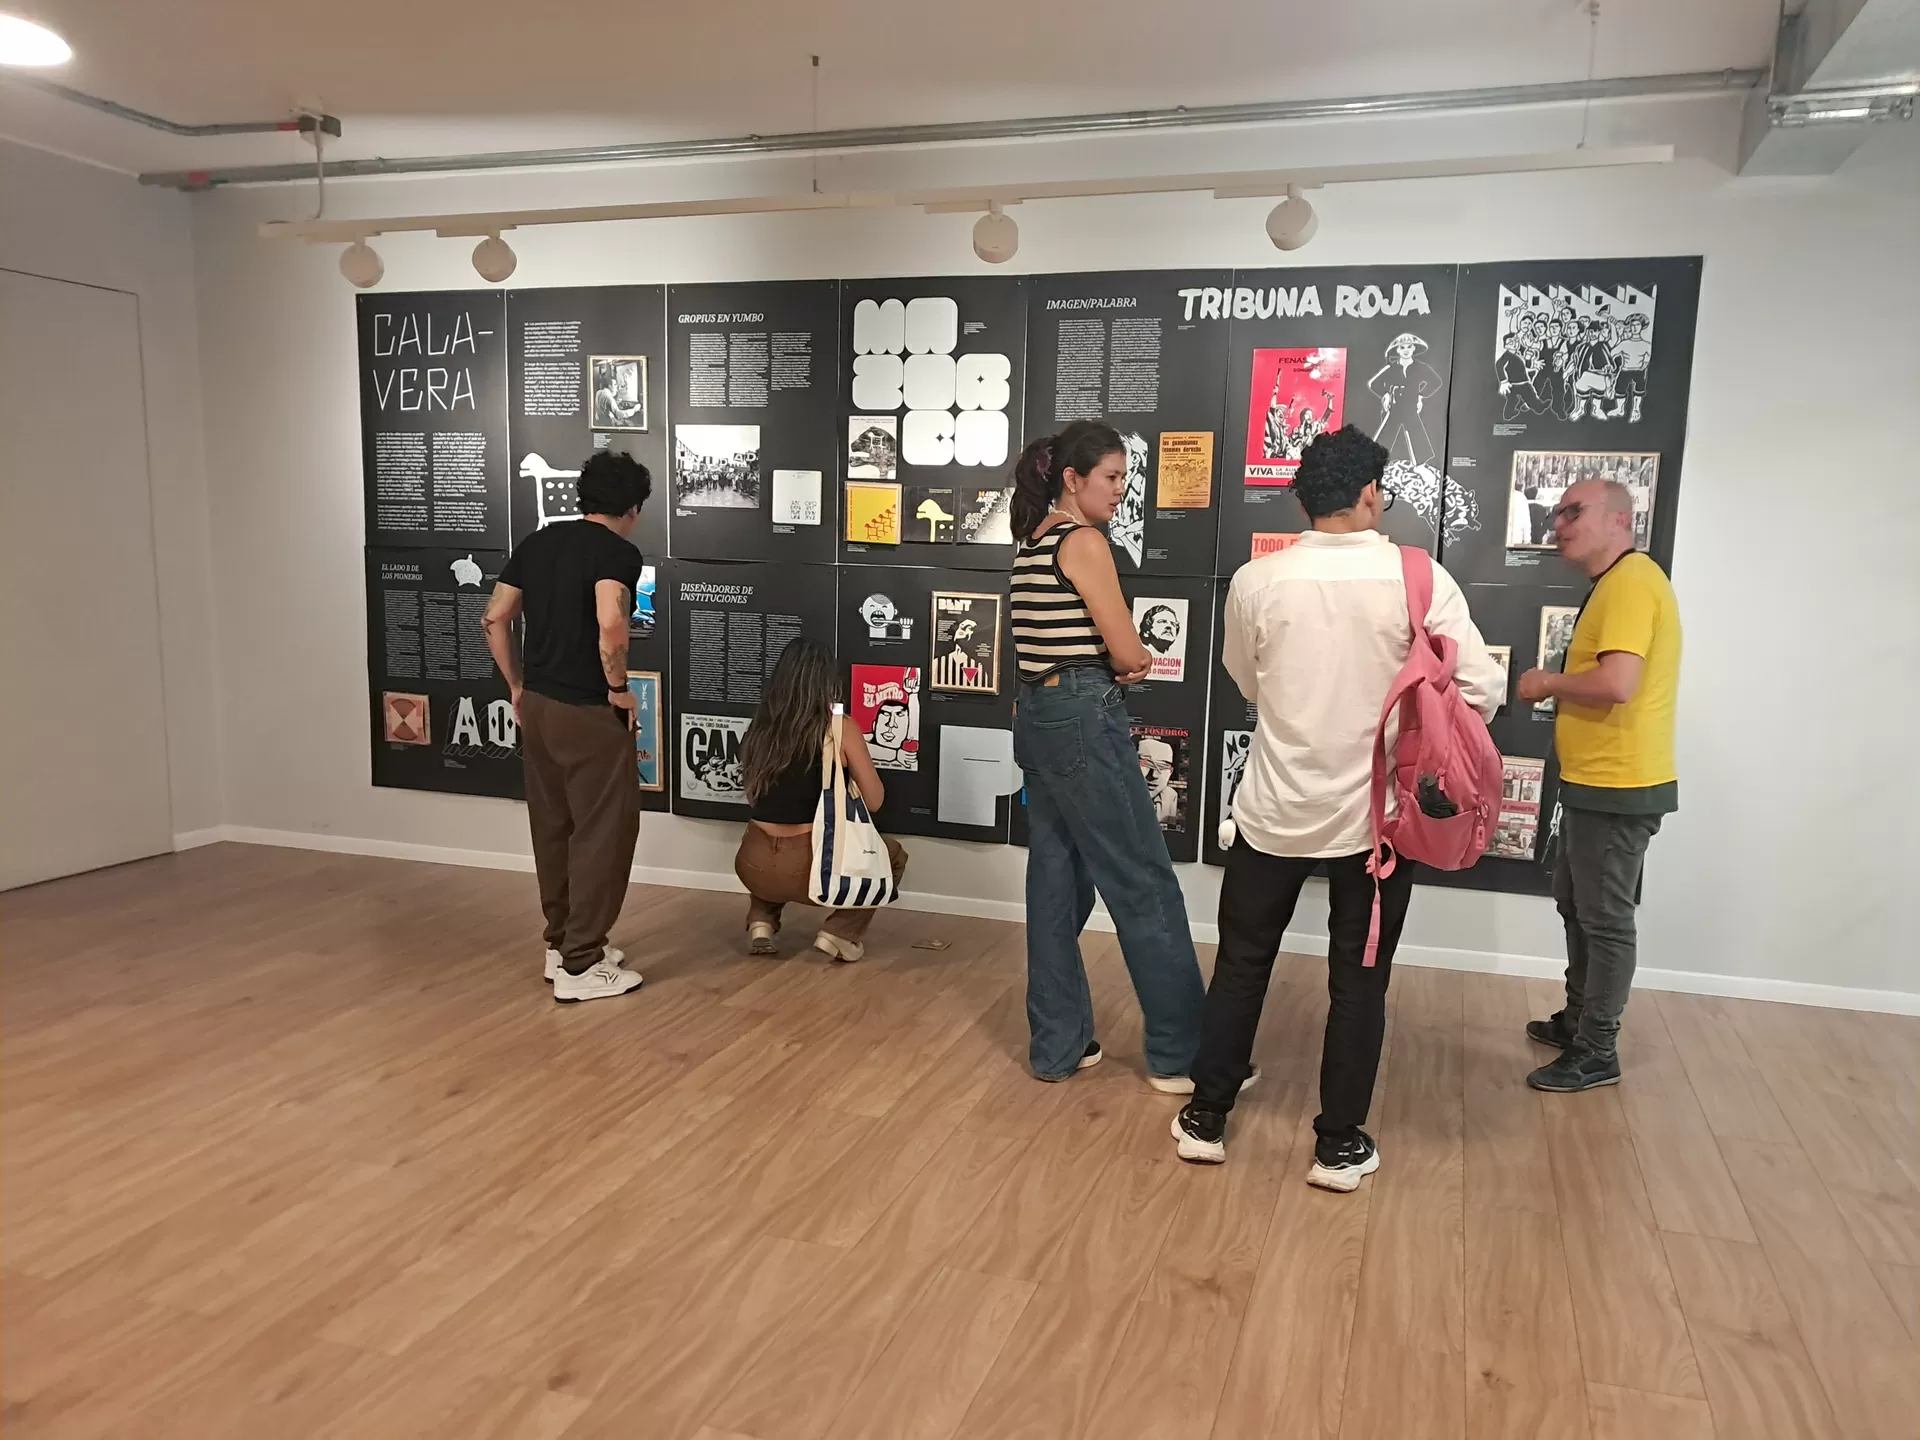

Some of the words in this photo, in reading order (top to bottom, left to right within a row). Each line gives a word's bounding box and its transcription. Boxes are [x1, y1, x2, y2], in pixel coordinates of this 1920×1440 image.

[1046, 298, 1137, 310] IMAGEN/PALABRA
[1178, 285, 1323, 321] TRIBUNA
[1335, 282, 1431, 318] ROJA
[678, 314, 716, 323] GROPIUS
[717, 313, 731, 322] EN
[732, 312, 764, 322] YUMBO
[375, 311, 494, 356] CALA-
[373, 367, 475, 411] VERA
[1249, 467, 1273, 476] VIVA
[1254, 538, 1284, 553] TODO
[382, 563, 388, 571] EL
[390, 563, 406, 571] LADO
[411, 564, 419, 572] DE
[680, 581, 740, 594] DISEÑADORES
[741, 585, 754, 595] DE
[680, 592, 748, 604] INSTITUCIONES
[1158, 668, 1180, 676] nunca!
